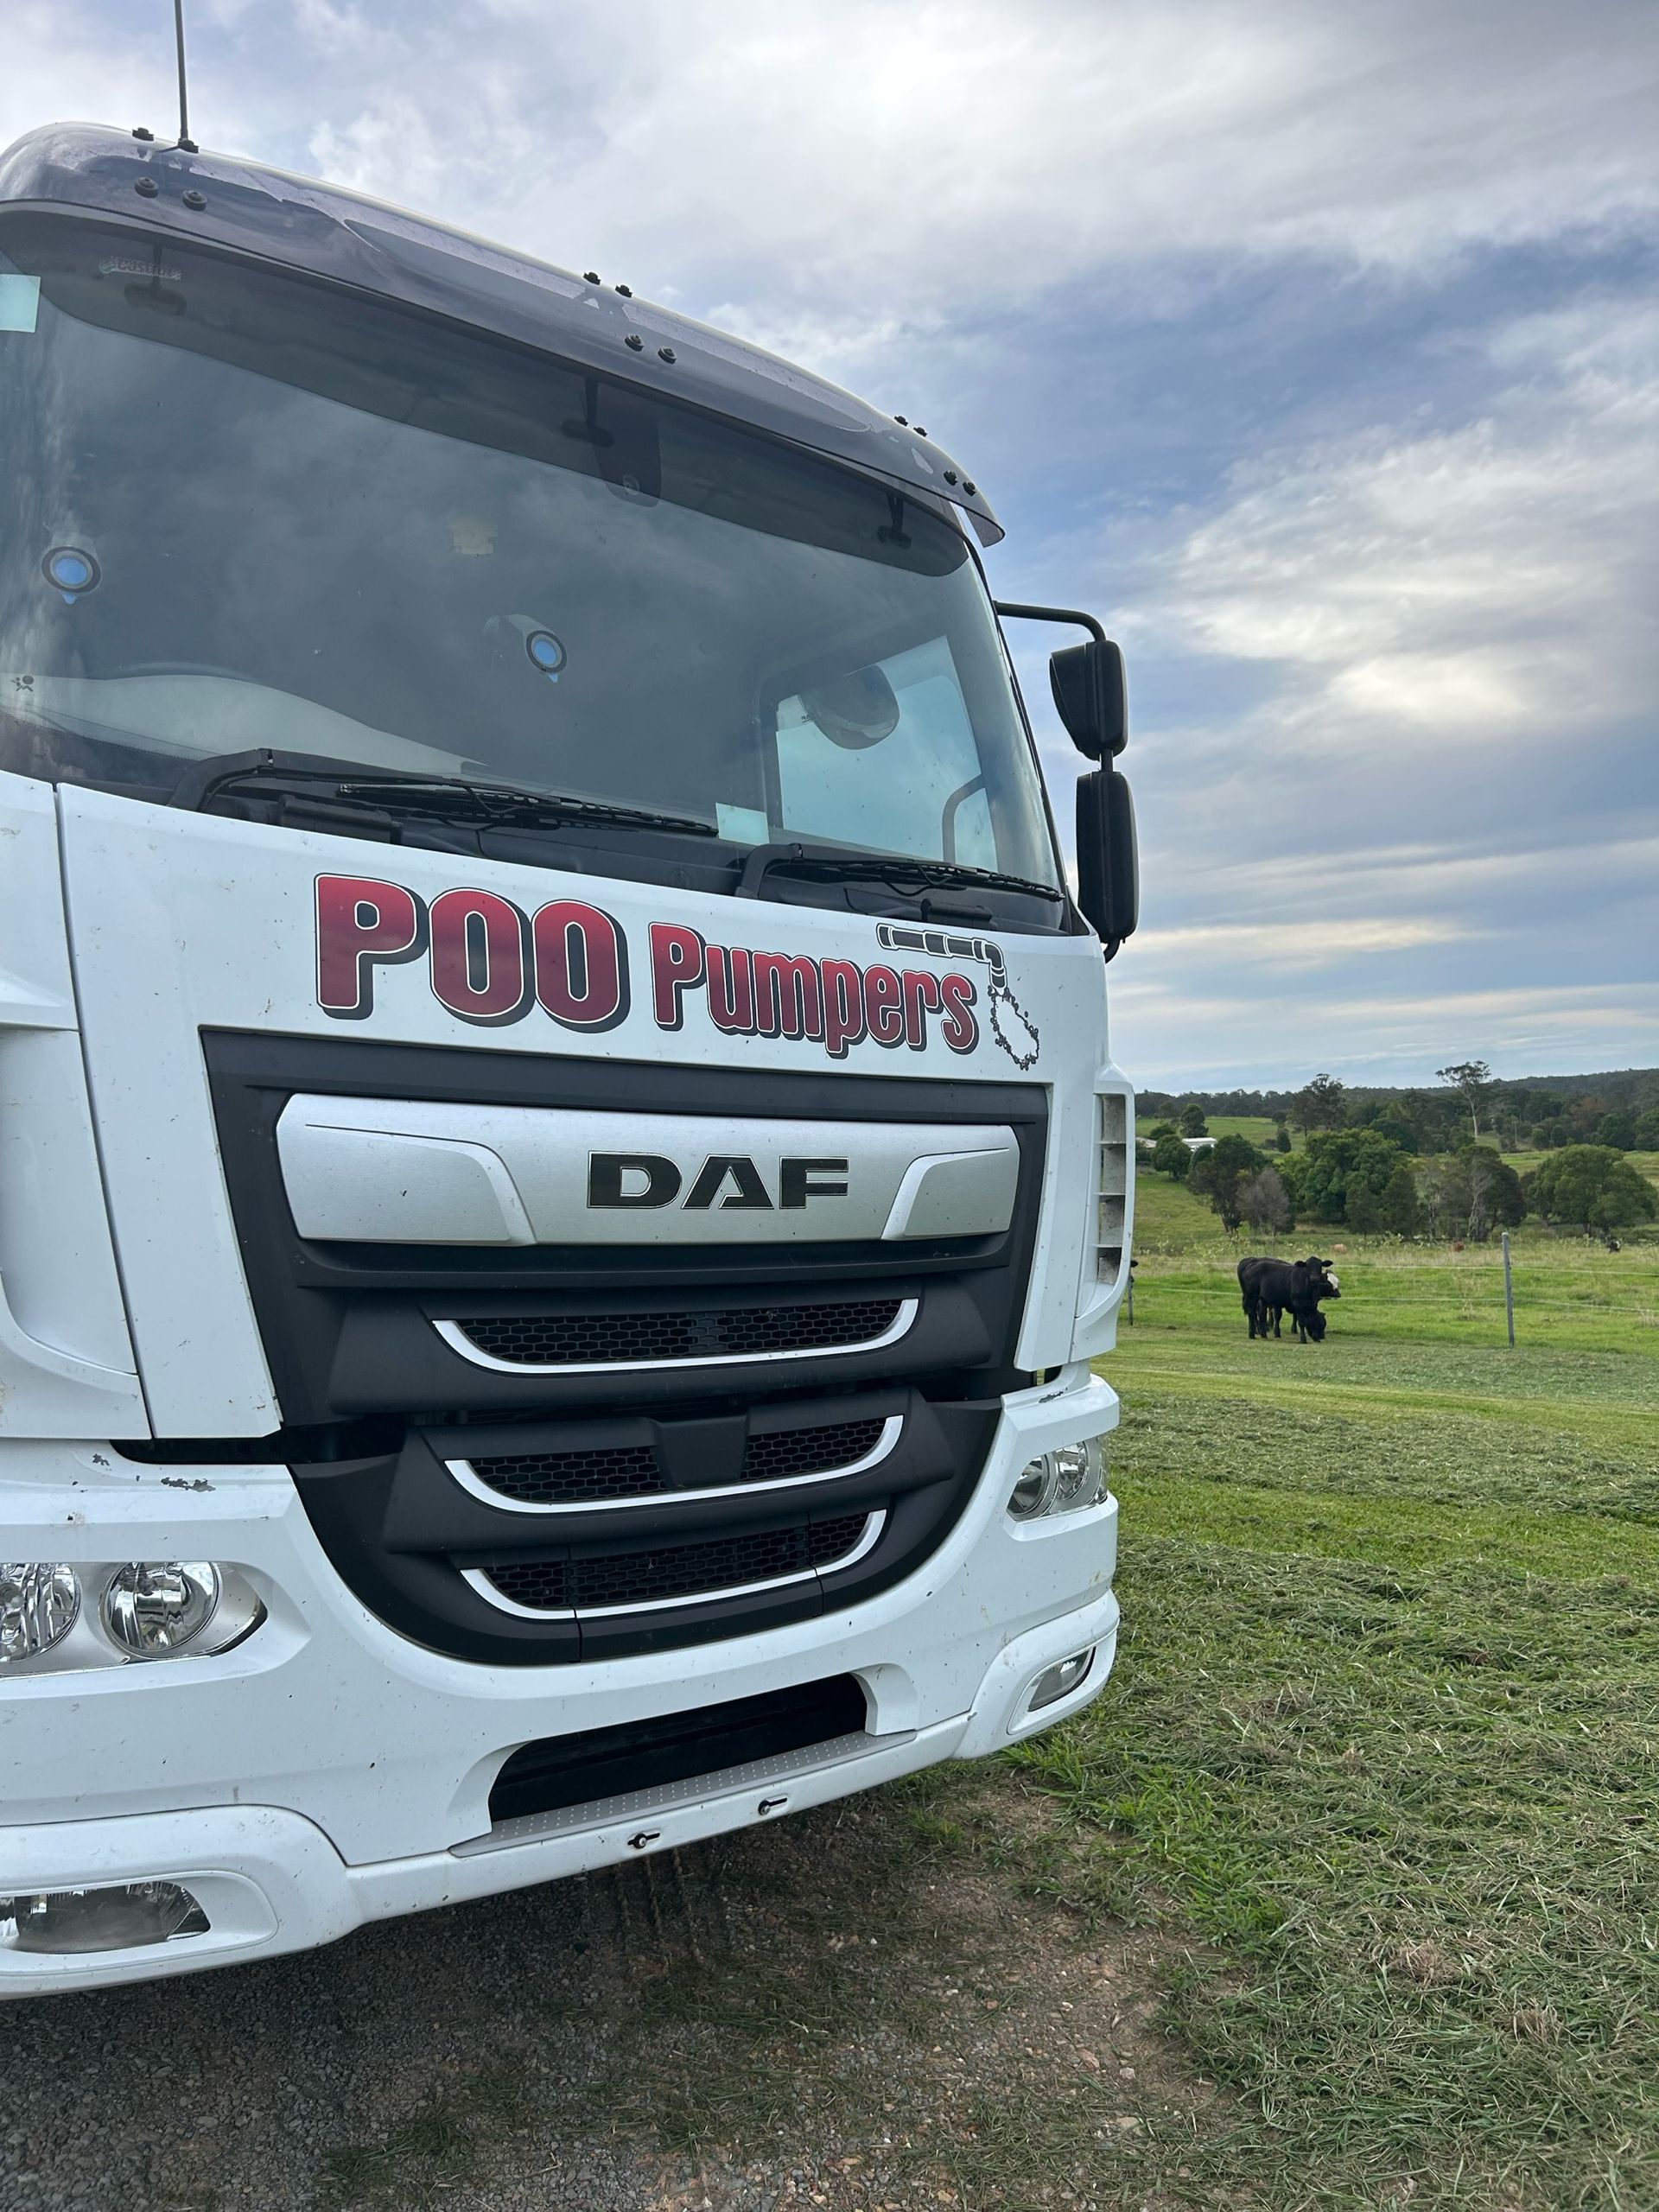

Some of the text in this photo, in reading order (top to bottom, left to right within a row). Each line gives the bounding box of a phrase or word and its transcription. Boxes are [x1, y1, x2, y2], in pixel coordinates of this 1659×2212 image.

[315, 873, 979, 1059] POO Pumpers
[587, 1150, 849, 1211] DAF
